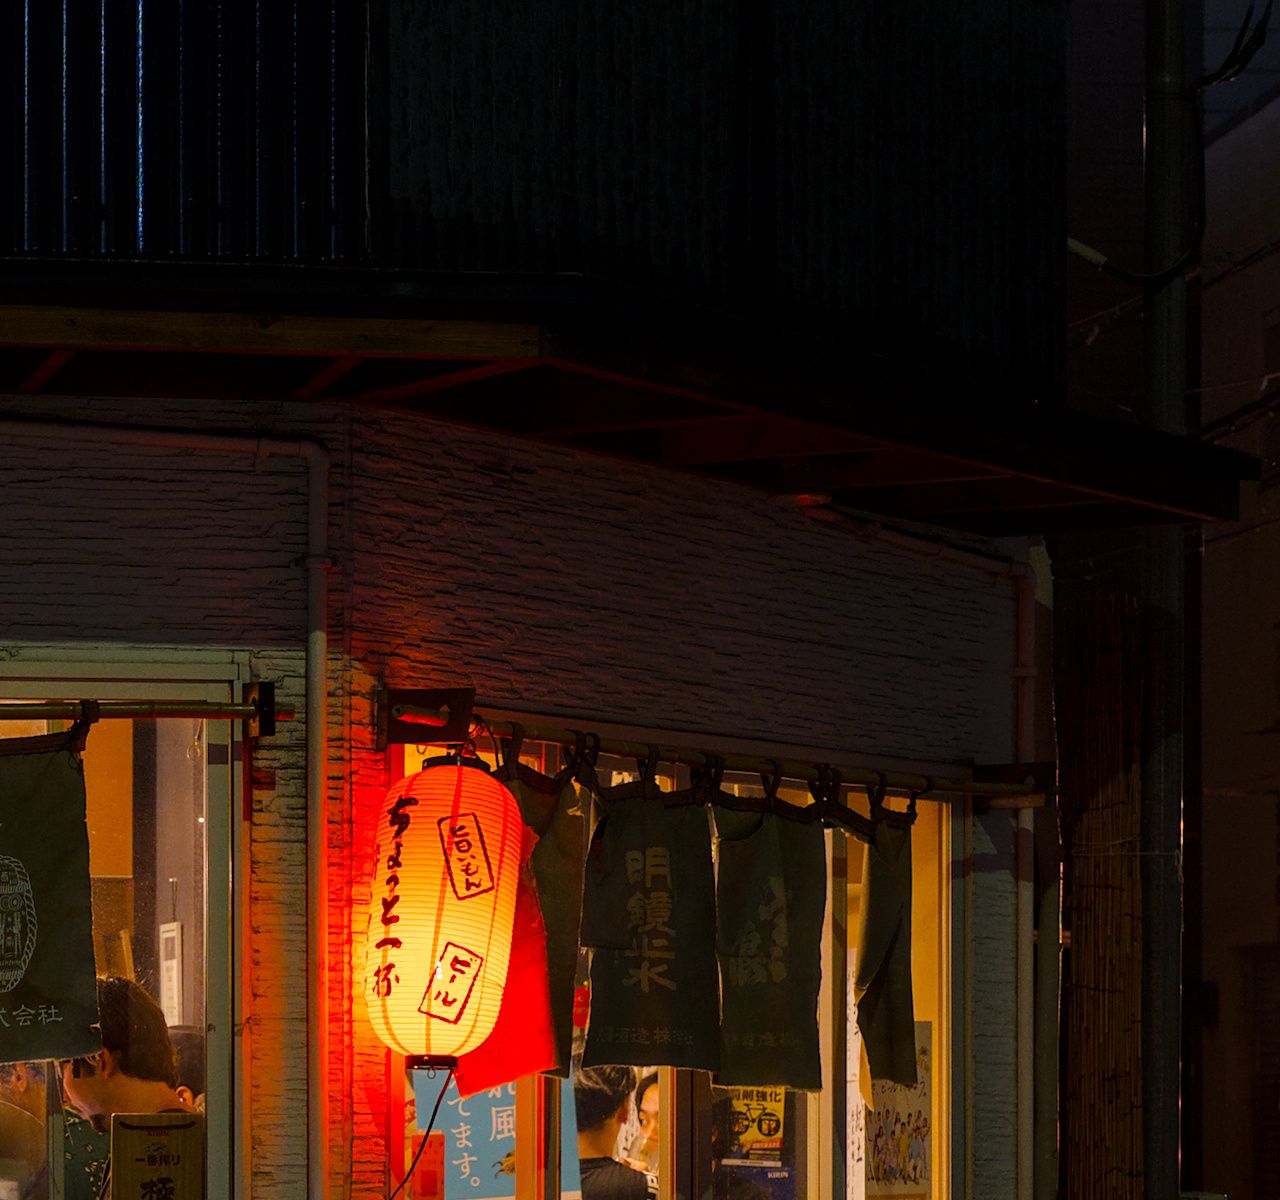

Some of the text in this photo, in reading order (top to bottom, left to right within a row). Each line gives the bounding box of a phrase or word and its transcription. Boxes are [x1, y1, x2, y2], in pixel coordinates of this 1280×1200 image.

[372, 794, 419, 998] ちょっと一杯
[450, 824, 482, 892] 旨いもん
[622, 847, 677, 992] 明鏡止水
[433, 955, 479, 1008] ビール
[447, 1074, 481, 1187] てます。
